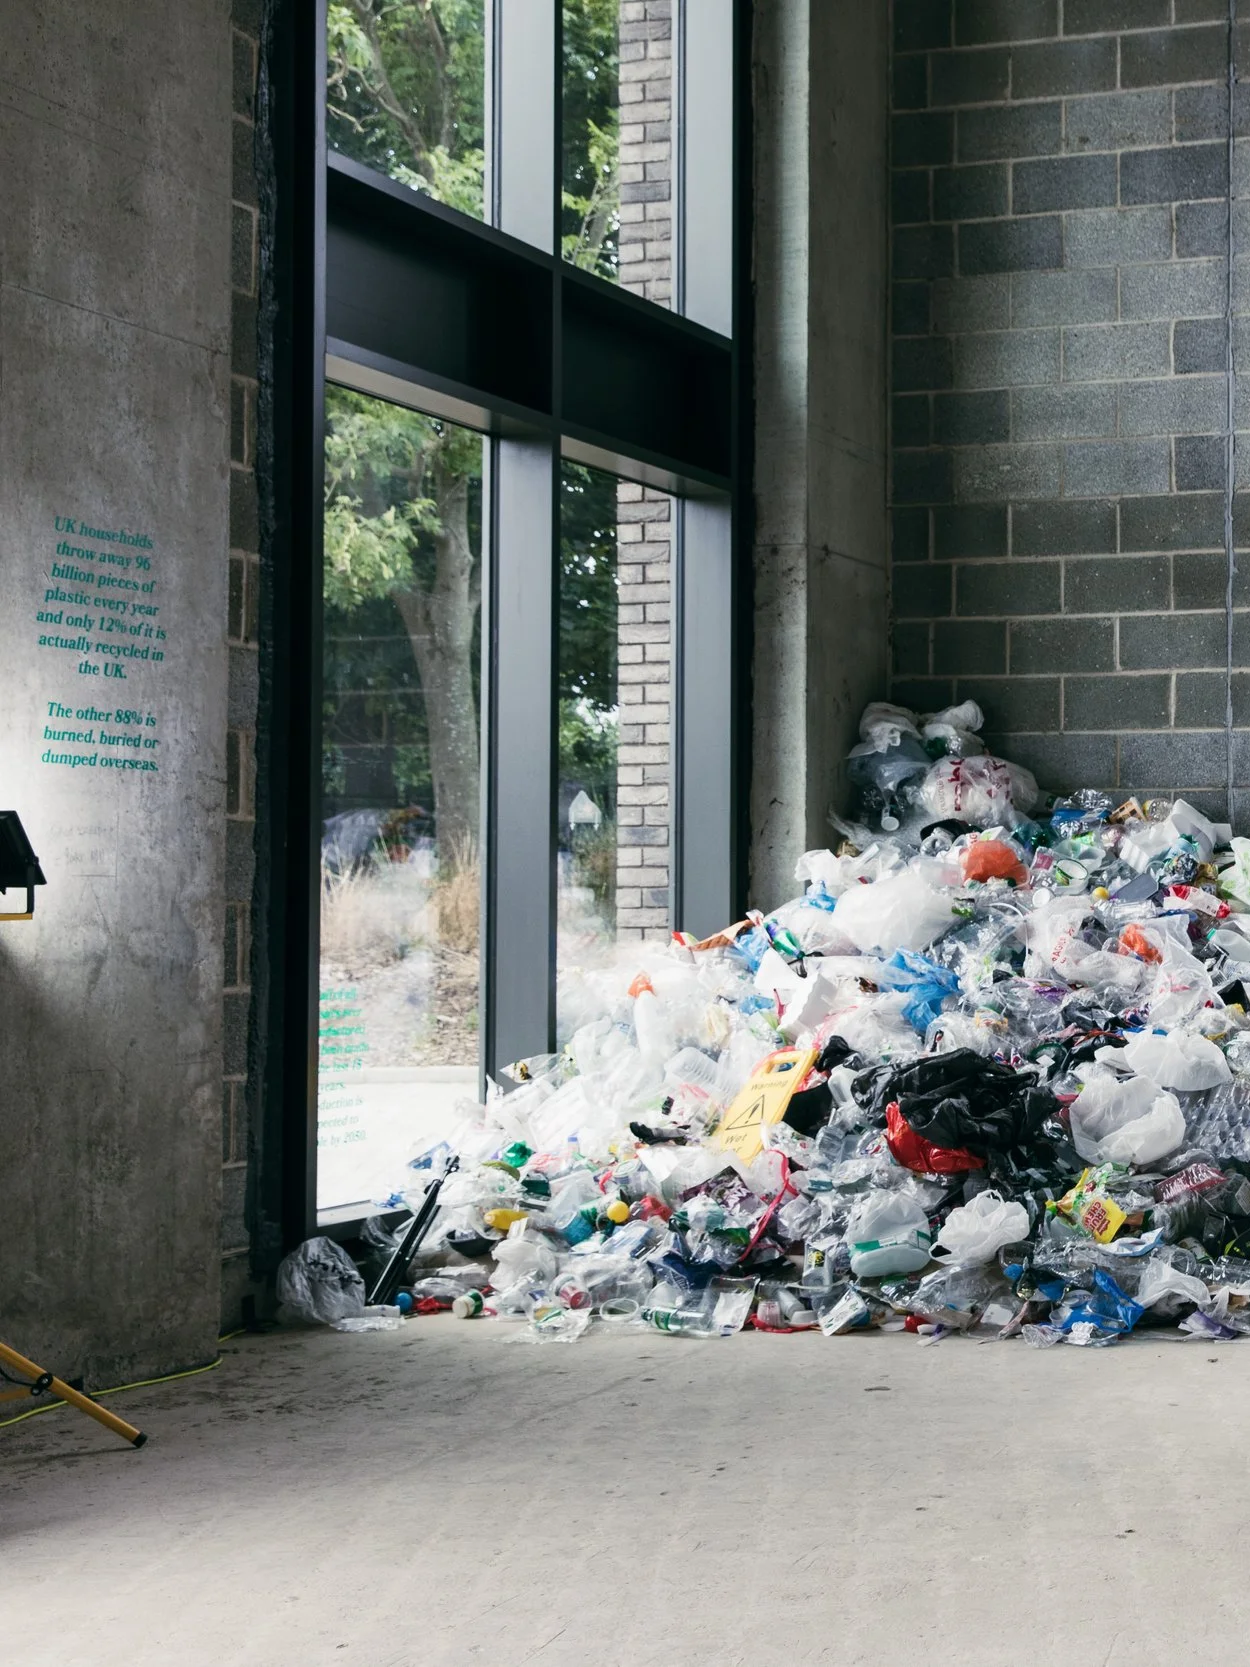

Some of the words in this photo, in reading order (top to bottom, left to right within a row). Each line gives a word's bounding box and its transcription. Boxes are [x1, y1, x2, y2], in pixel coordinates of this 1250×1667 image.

[54, 515, 76, 533] UK
[80, 522, 154, 550] households
[56, 541, 96, 562] throw
[99, 553, 132, 569] away
[135, 555, 151, 571] 96
[51, 563, 95, 583] billion
[97, 575, 139, 591] pieces
[141, 580, 157, 594] of
[44, 587, 91, 606] plastic
[93, 599, 129, 614] every
[131, 602, 160, 617] year
[36, 610, 62, 625] and
[66, 614, 95, 632] only
[99, 617, 126, 632] 12%
[129, 624, 144, 637] of
[144, 626, 154, 638] it
[155, 629, 166, 640] is
[38, 635, 93, 654] actually
[95, 643, 149, 660] recycled
[151, 649, 164, 661] in
[78, 661, 100, 675] the
[103, 663, 127, 679] UK.
[47, 702, 73, 718] The
[76, 707, 113, 722] other
[114, 709, 143, 725] 88%
[145, 712, 157, 727] is
[99, 731, 141, 748] buried
[143, 738, 160, 749] or
[41, 750, 97, 768] dumped
[100, 756, 159, 772] overseas.
[751, 1080, 789, 1091] Warning
[725, 1133, 748, 1145] Wet
